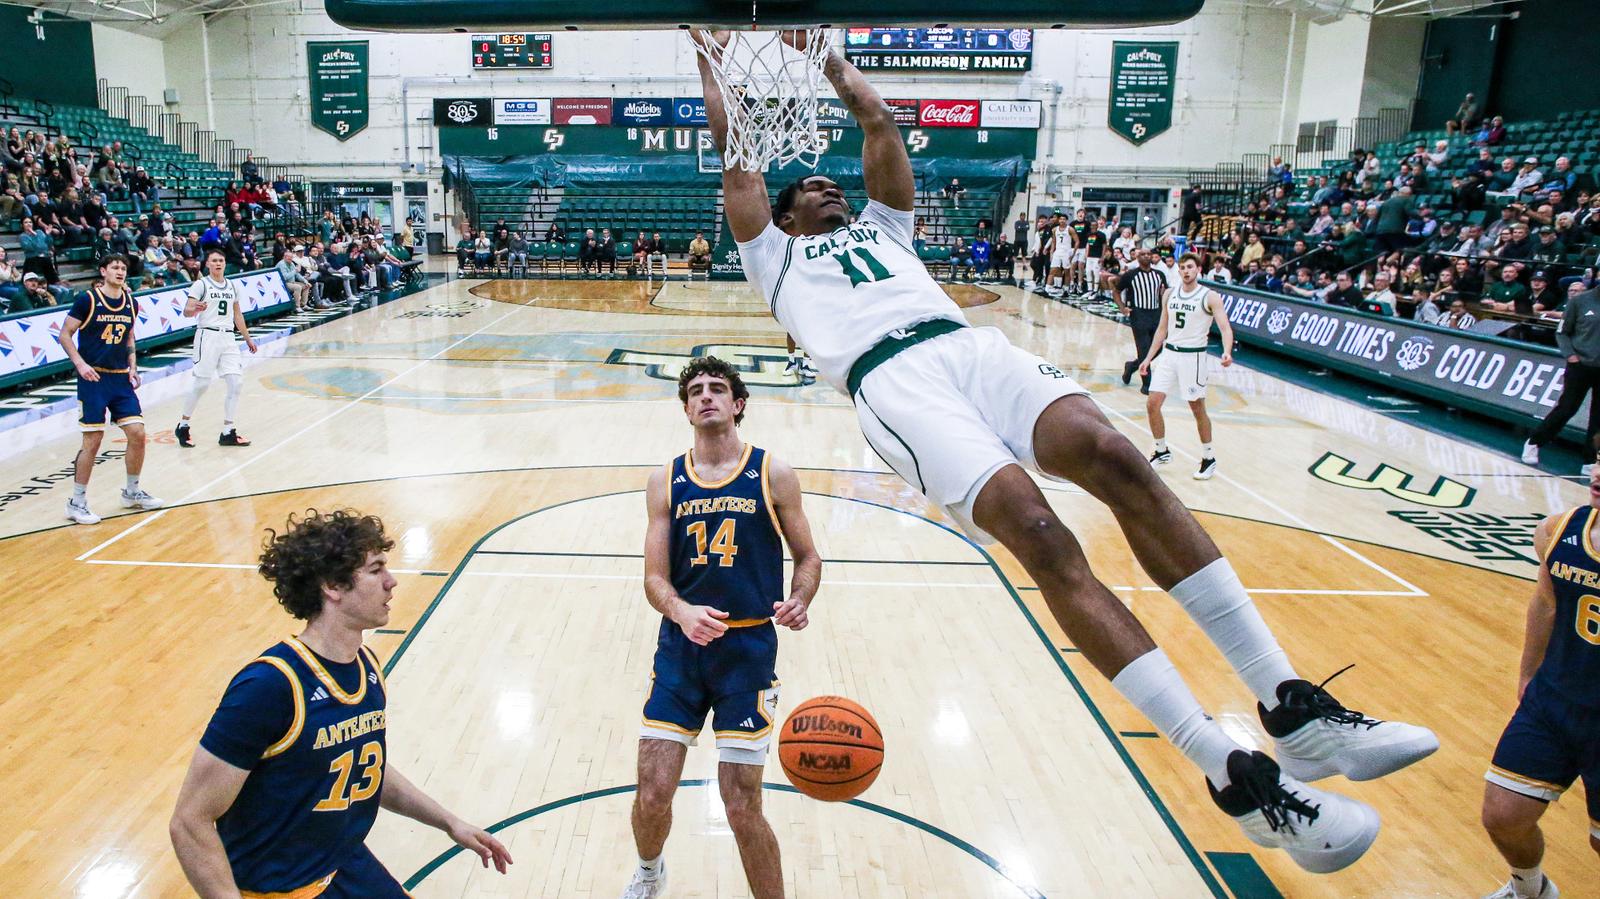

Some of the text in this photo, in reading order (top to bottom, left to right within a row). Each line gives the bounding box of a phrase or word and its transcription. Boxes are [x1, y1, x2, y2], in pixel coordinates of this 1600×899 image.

[482, 42, 489, 52] 0
[502, 35, 524, 44] 18:54
[543, 42, 549, 51] 0
[322, 51, 354, 62] CAL POLY
[851, 56, 1027, 68] THE SALMONSON FAMILY
[1146, 52, 1162, 62] POLY
[447, 105, 478, 119] 805
[628, 102, 657, 114] Modelo
[828, 106, 849, 119] POLY
[920, 104, 977, 123] Coca-Cola
[487, 128, 498, 140] 15
[626, 128, 638, 140] 16
[832, 129, 843, 142] 17
[977, 130, 988, 143] 18
[804, 239, 839, 260] CAL
[832, 246, 896, 289] 11
[217, 300, 228, 316] 9
[1181, 304, 1196, 312] POLY
[1229, 298, 1267, 329] BEER
[1175, 312, 1186, 328] 5
[1266, 309, 1293, 332] 805
[101, 323, 127, 345] 43
[1291, 312, 1395, 362] GOOD TIMES
[1395, 339, 1435, 367] 805
[1434, 345, 1567, 408] COLD BEE
[675, 496, 757, 519] ANTEATERS
[686, 518, 738, 567] 14
[792, 714, 862, 739] Wilson
[798, 751, 852, 771] NCAA
[313, 741, 384, 812] 13
